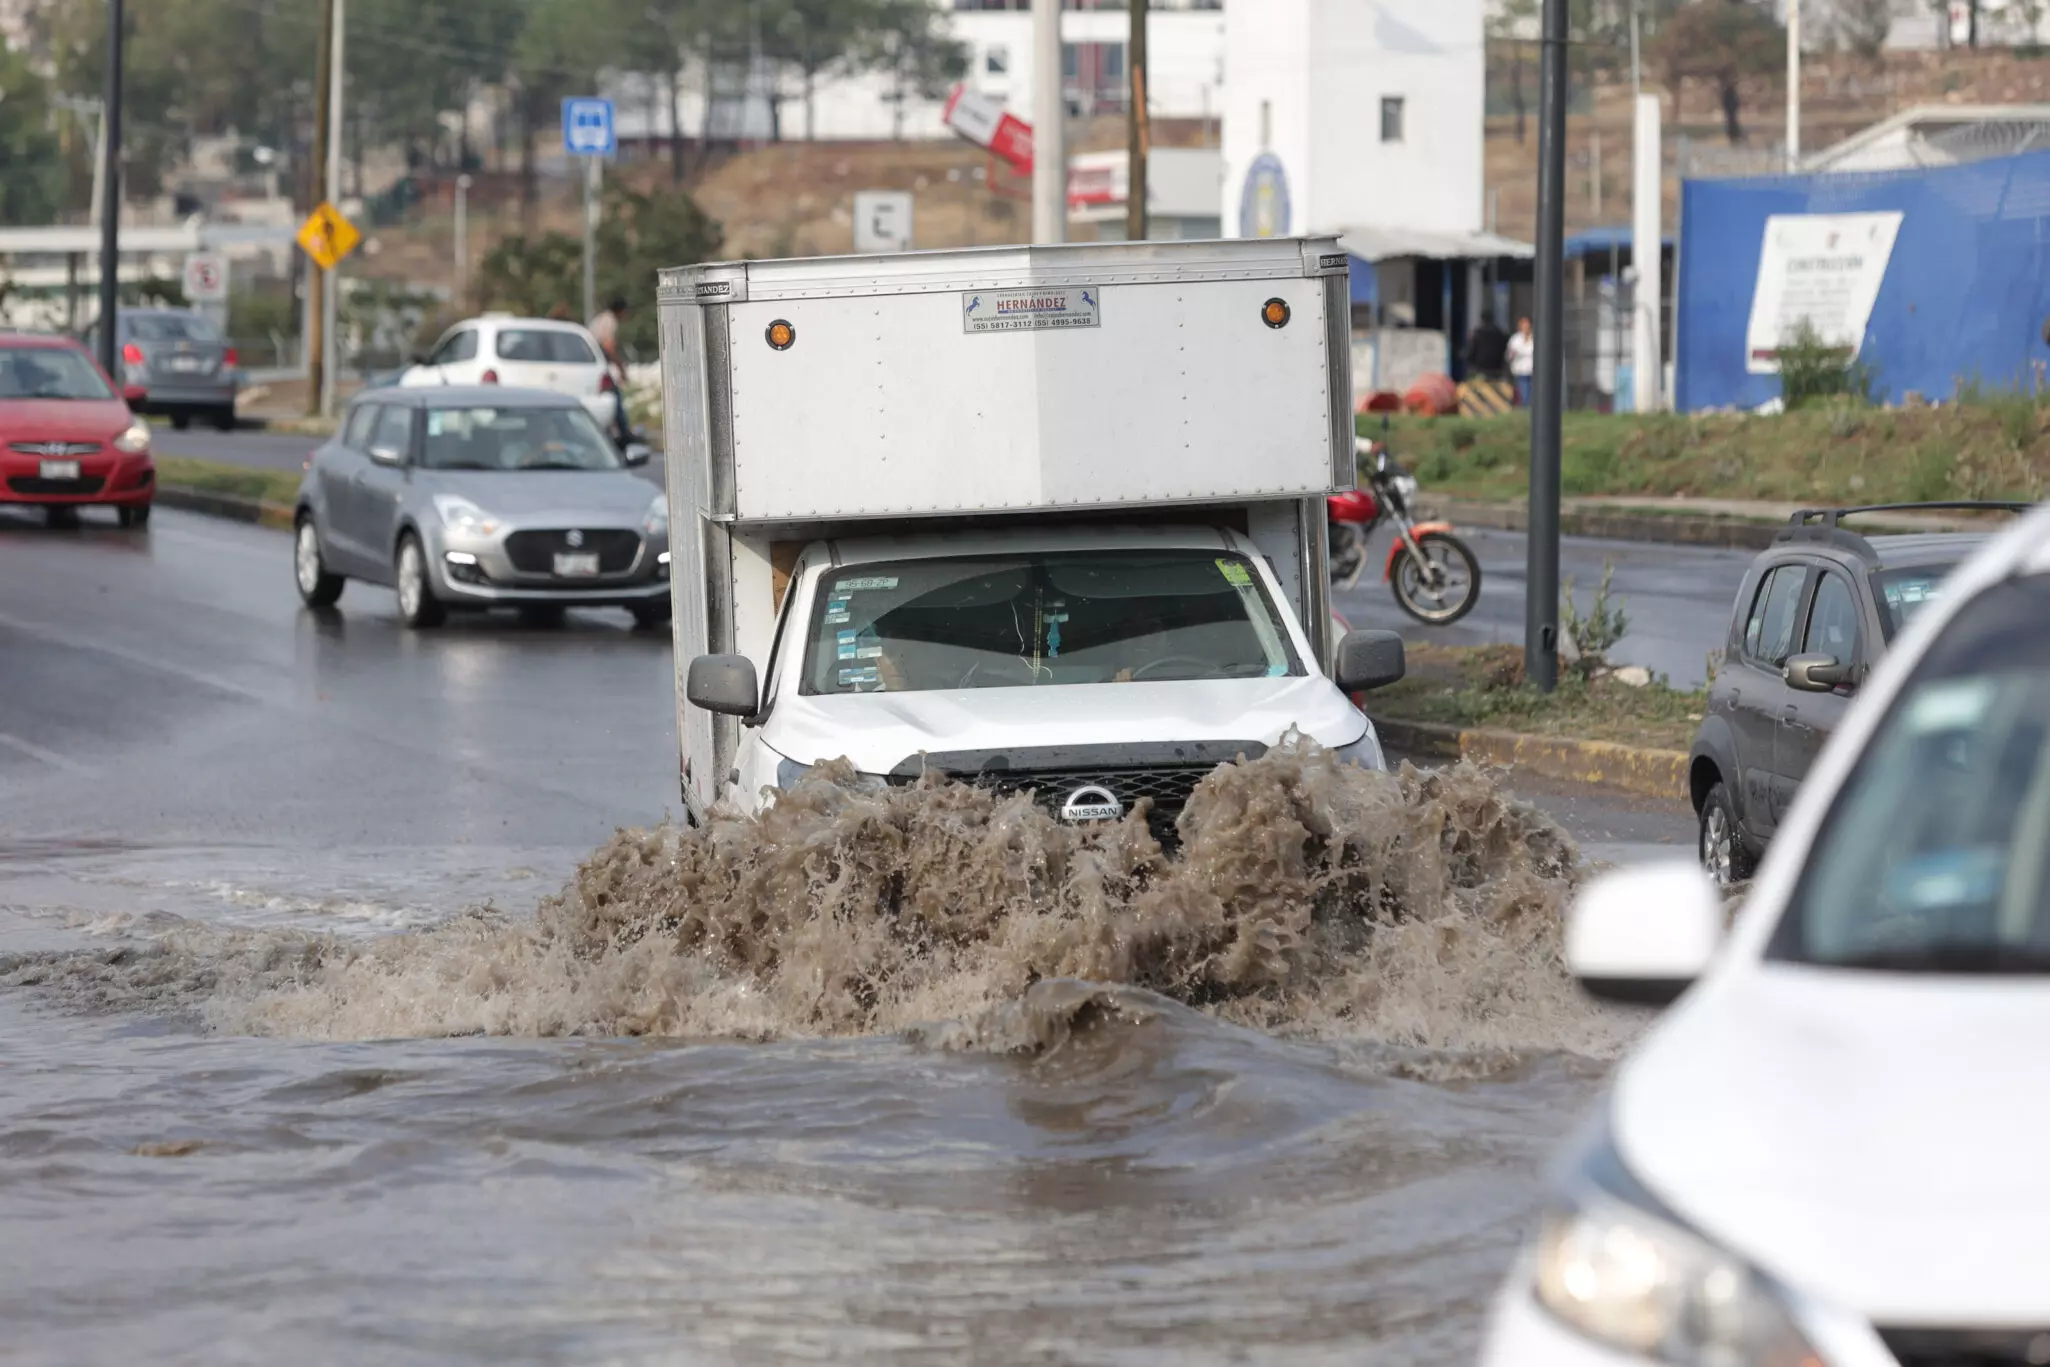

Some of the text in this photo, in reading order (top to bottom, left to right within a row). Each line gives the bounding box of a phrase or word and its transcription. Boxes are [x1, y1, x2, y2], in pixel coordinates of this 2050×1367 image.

[997, 296, 1066, 310] HERNÁNDEZ
[991, 320, 1032, 329] 5817-3112
[1034, 319, 1049, 327] (55)
[1051, 317, 1091, 326] 4995-9638
[1068, 807, 1117, 817] NISSAN
